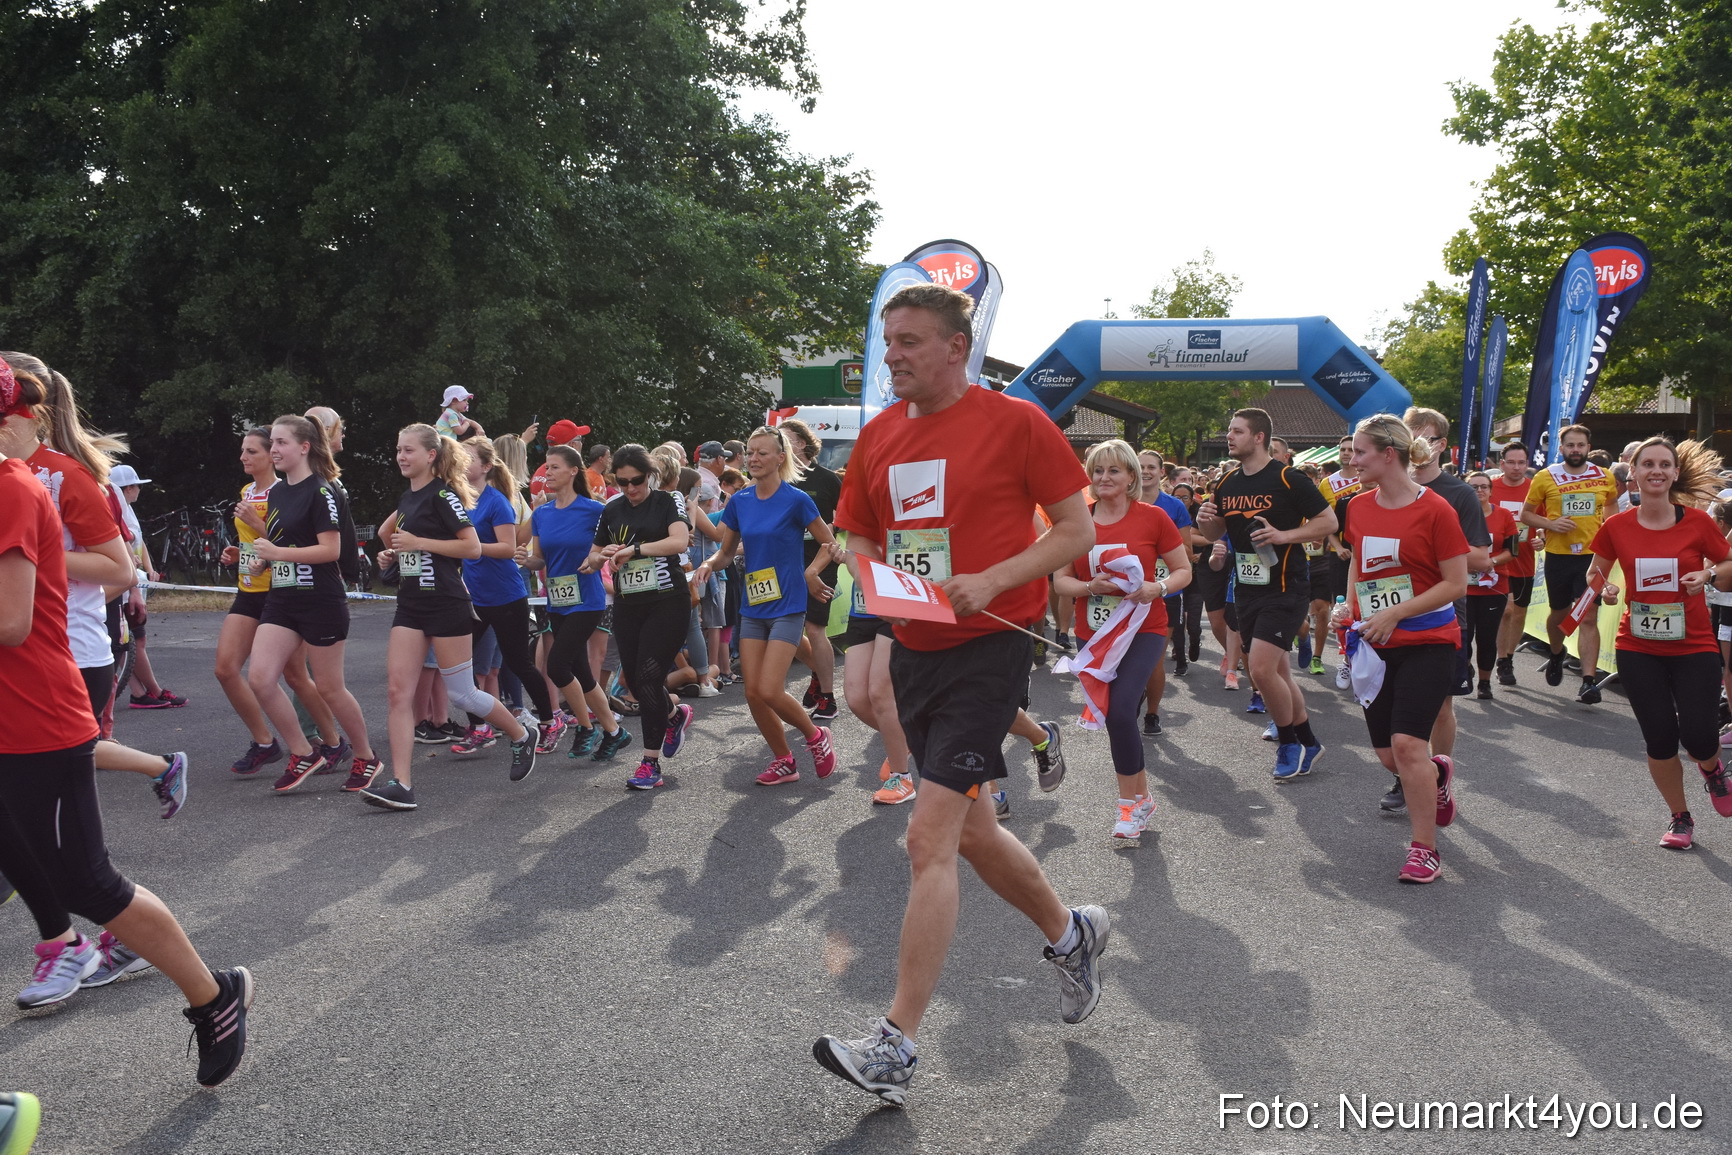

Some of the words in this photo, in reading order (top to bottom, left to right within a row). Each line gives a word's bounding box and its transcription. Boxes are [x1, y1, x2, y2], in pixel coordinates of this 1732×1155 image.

[927, 261, 975, 287] ervis
[1594, 259, 1639, 286] ervis
[975, 287, 993, 342] AUTOMOBILE
[1176, 349, 1249, 362] firmenlauf
[1037, 372, 1076, 383] Fischer
[1558, 484, 1582, 494] MAX
[325, 490, 339, 523] now
[446, 491, 469, 520] now
[672, 490, 688, 519] now
[1227, 494, 1273, 509] WINGS
[1566, 501, 1591, 511] 1620
[419, 550, 435, 587] now
[894, 553, 931, 575] 555
[1241, 564, 1260, 576] 282
[296, 562, 315, 586] no
[622, 569, 651, 585] 1757
[656, 556, 674, 591] now
[550, 585, 575, 599] 1132
[748, 579, 773, 597] 1131
[1370, 591, 1401, 609] 510
[1640, 616, 1670, 630] 471
